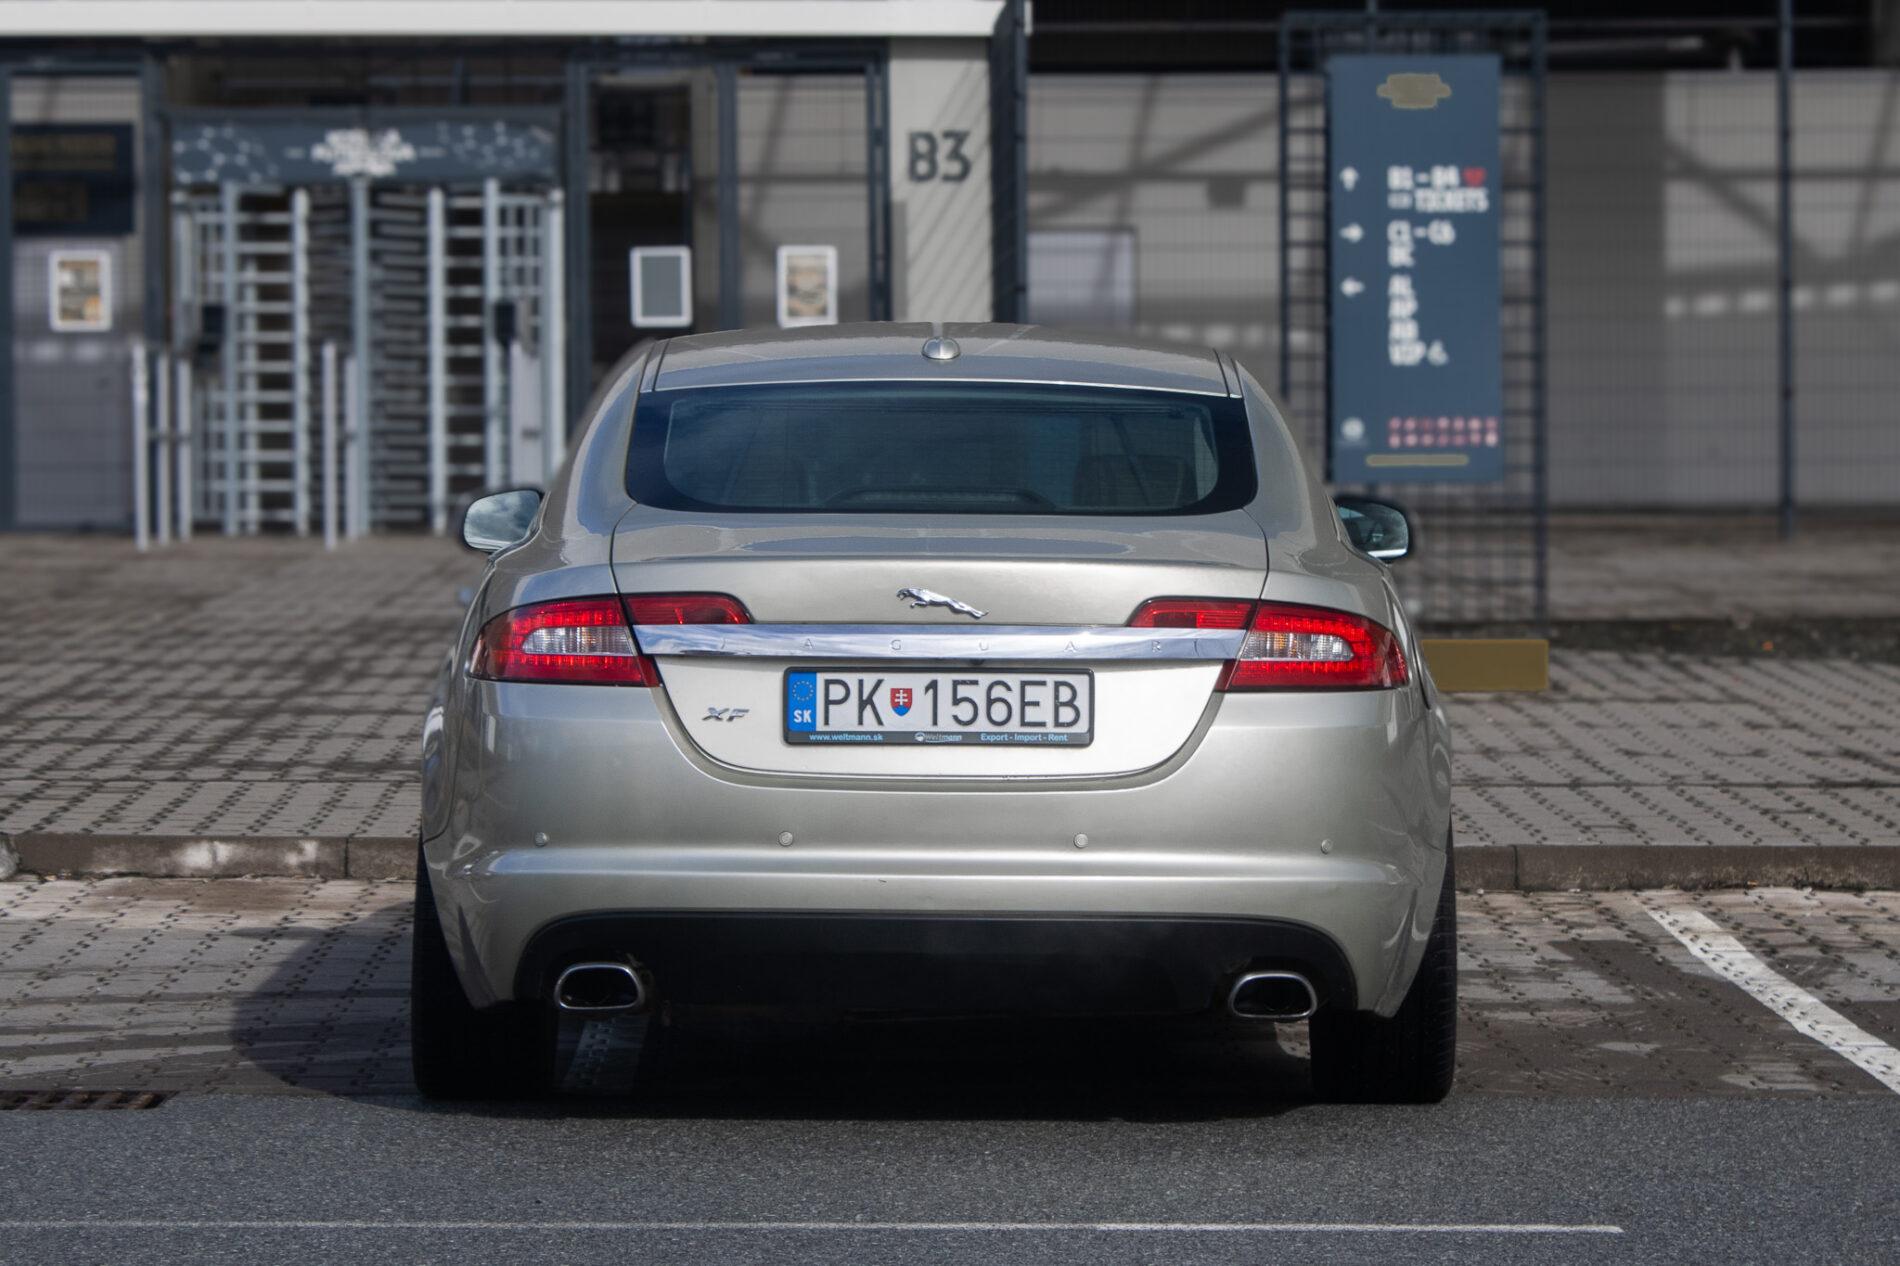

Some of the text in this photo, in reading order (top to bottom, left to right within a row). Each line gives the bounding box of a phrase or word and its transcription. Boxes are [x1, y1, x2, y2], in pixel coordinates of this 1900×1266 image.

[909, 130, 971, 182] B3
[823, 679, 1081, 727] PK 156EB
[702, 706, 749, 722] XF
[793, 709, 812, 723] SK
[809, 733, 883, 742] www.weltmann.sk
[980, 733, 1008, 743] Export
[1014, 733, 1042, 743] Import
[1048, 733, 1068, 741] Rent
